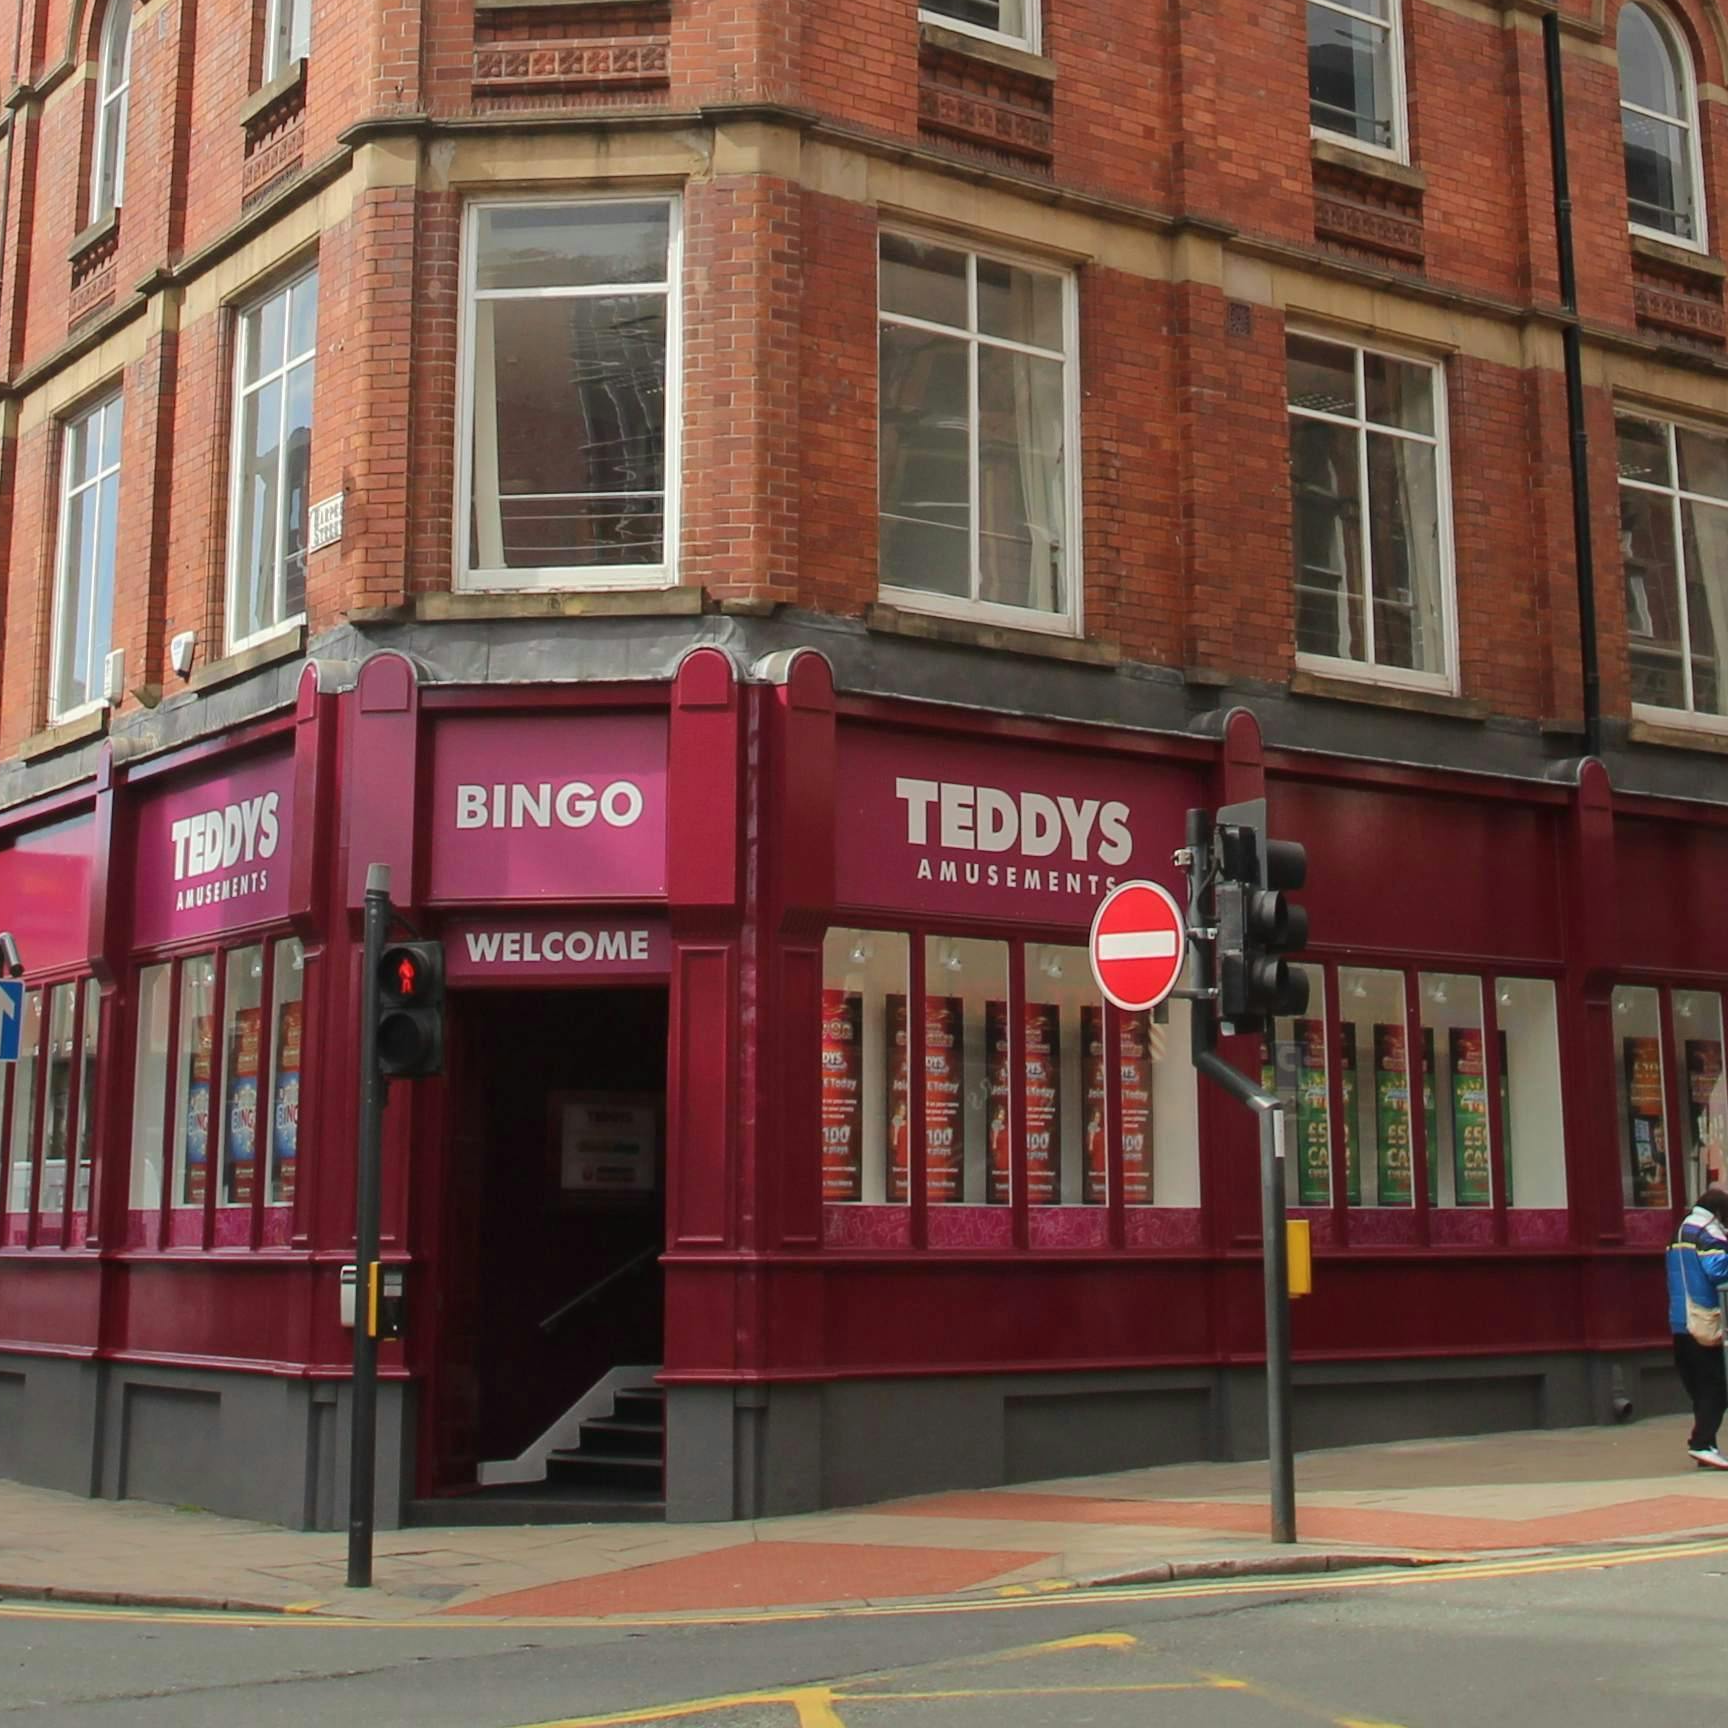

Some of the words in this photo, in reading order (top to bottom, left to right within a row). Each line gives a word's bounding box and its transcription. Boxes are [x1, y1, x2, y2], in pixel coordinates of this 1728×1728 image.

[456, 779, 644, 830] BINGO
[895, 776, 1134, 866] TEDDYS
[171, 791, 280, 881] TEDDYS
[176, 869, 268, 912] AMUSEMENTS
[917, 858, 1118, 897] AMUSEMENTS
[465, 930, 649, 962] WELCOME
